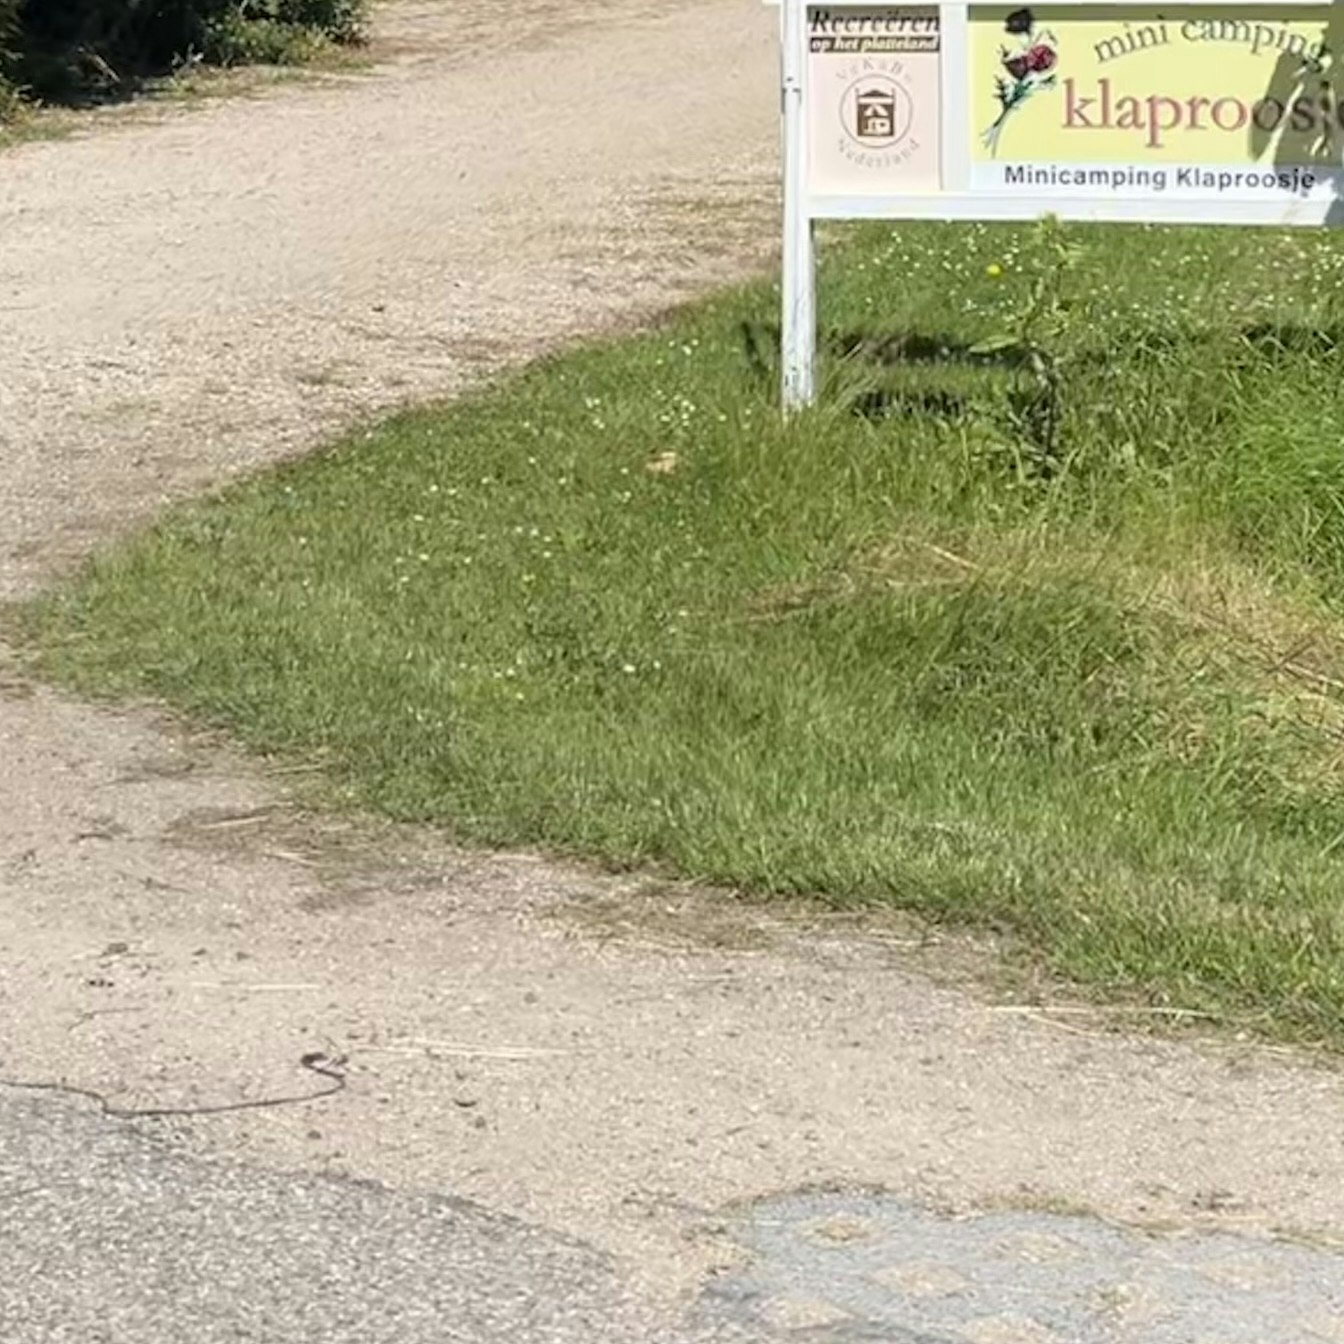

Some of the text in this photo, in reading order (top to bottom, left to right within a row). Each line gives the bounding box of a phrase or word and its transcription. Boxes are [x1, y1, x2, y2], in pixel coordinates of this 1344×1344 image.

[811, 10, 940, 33] Recreëren
[811, 37, 939, 53] op het platteland
[1094, 15, 1329, 72] mini camping
[1005, 165, 1315, 193] Minicamping Klaproosje
